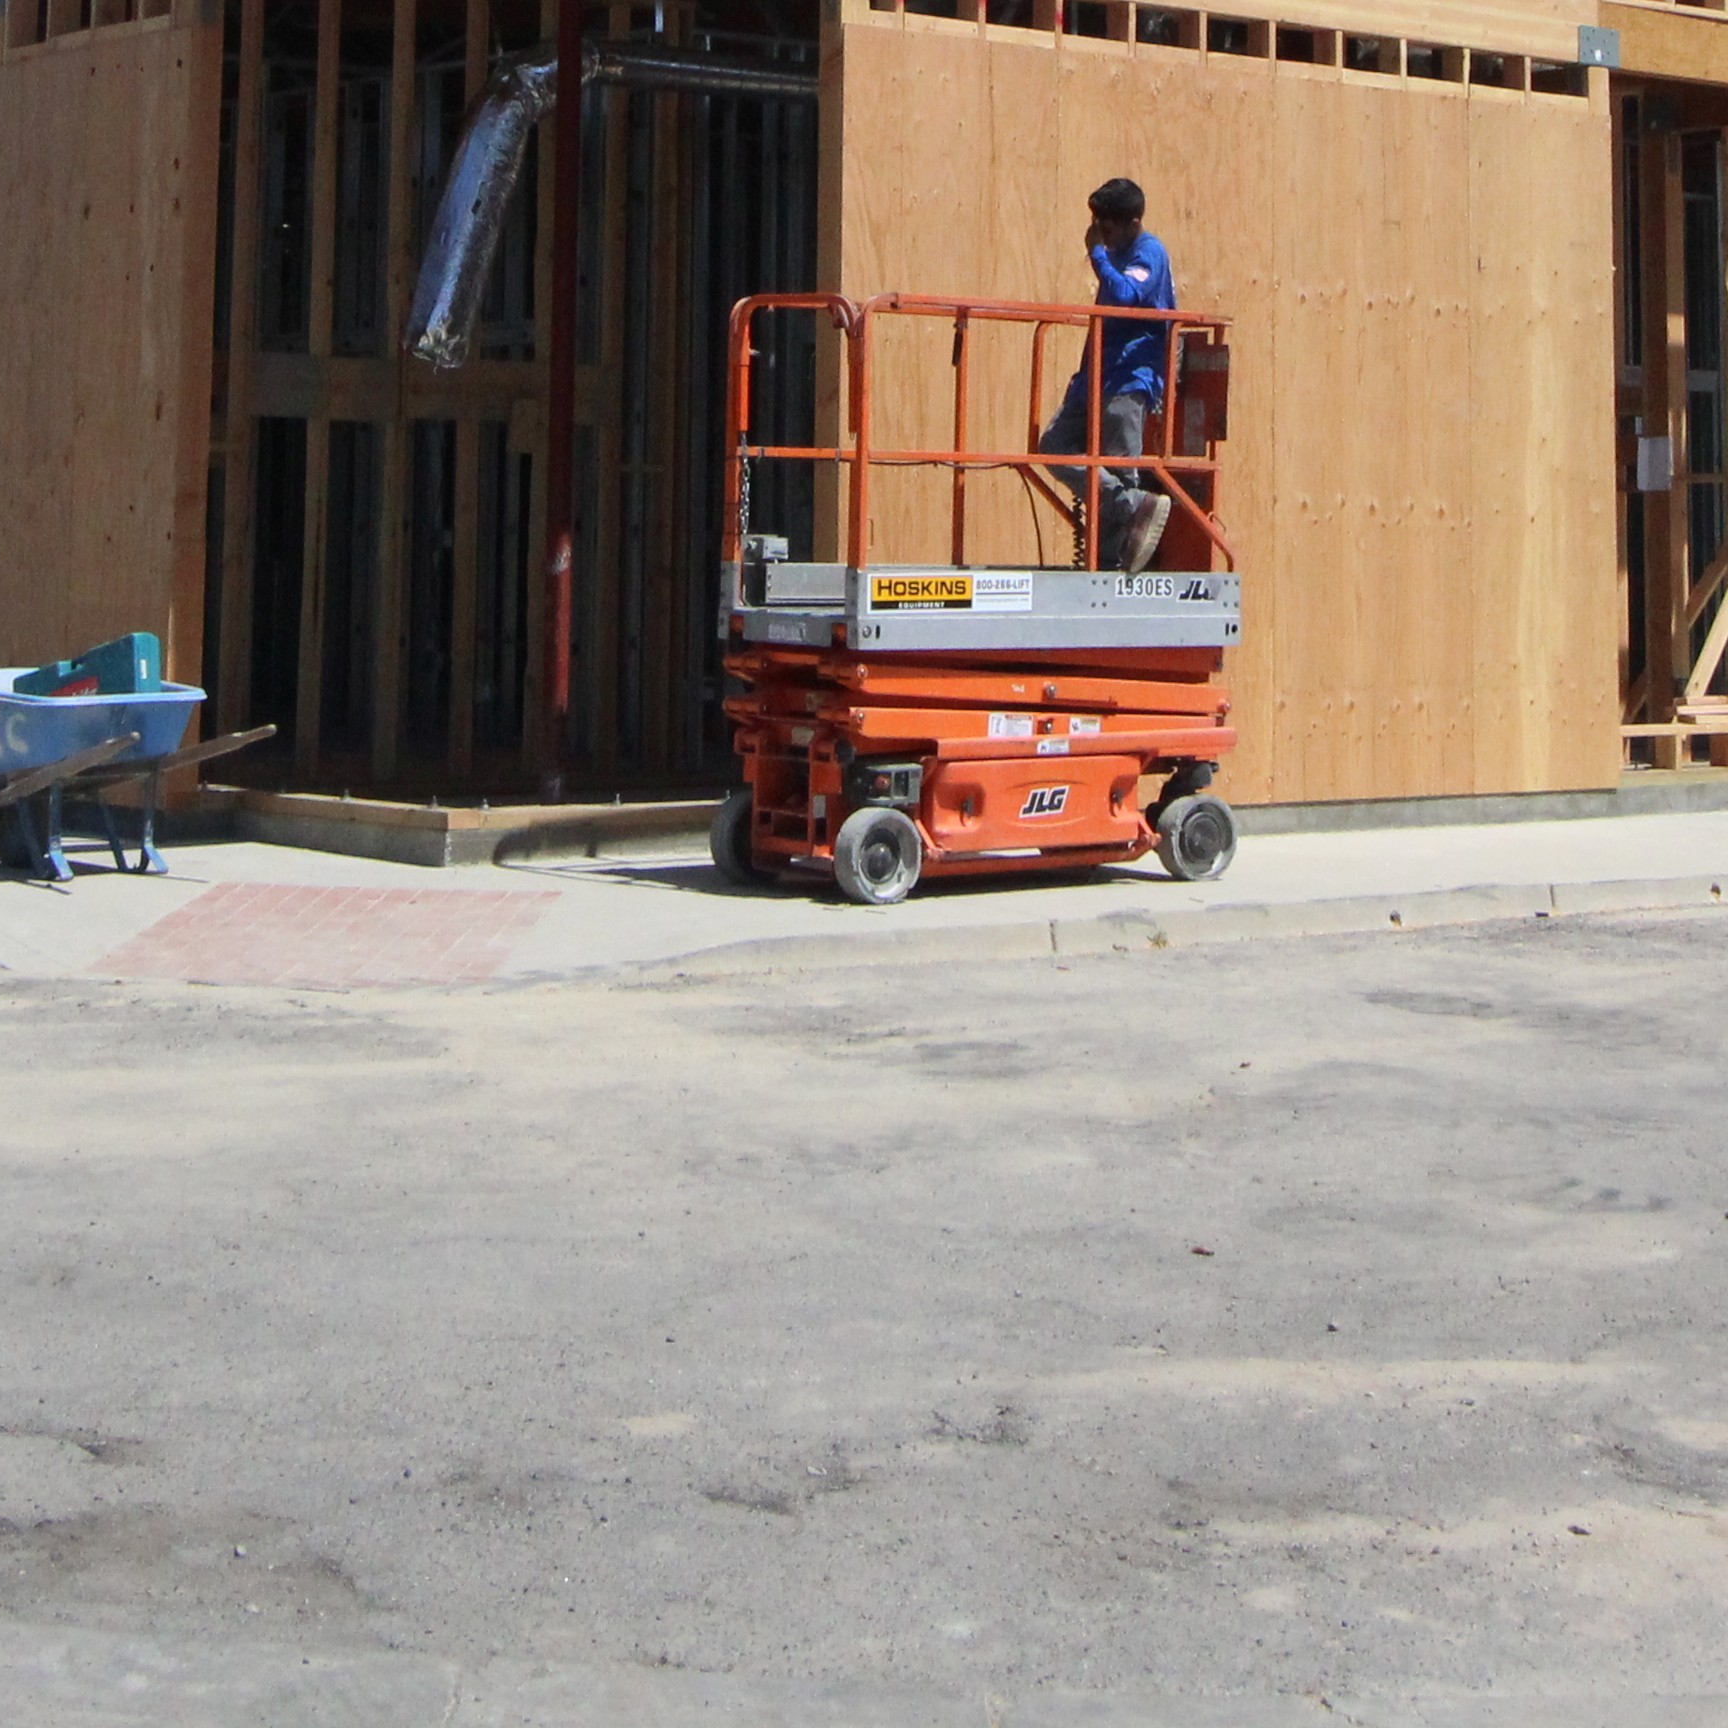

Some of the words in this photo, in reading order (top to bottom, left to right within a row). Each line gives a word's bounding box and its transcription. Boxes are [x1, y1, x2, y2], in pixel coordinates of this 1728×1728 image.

[877, 579, 966, 596] HOSKINS
[1116, 578, 1172, 596] 1930ES
[1021, 788, 1067, 815] JLG
